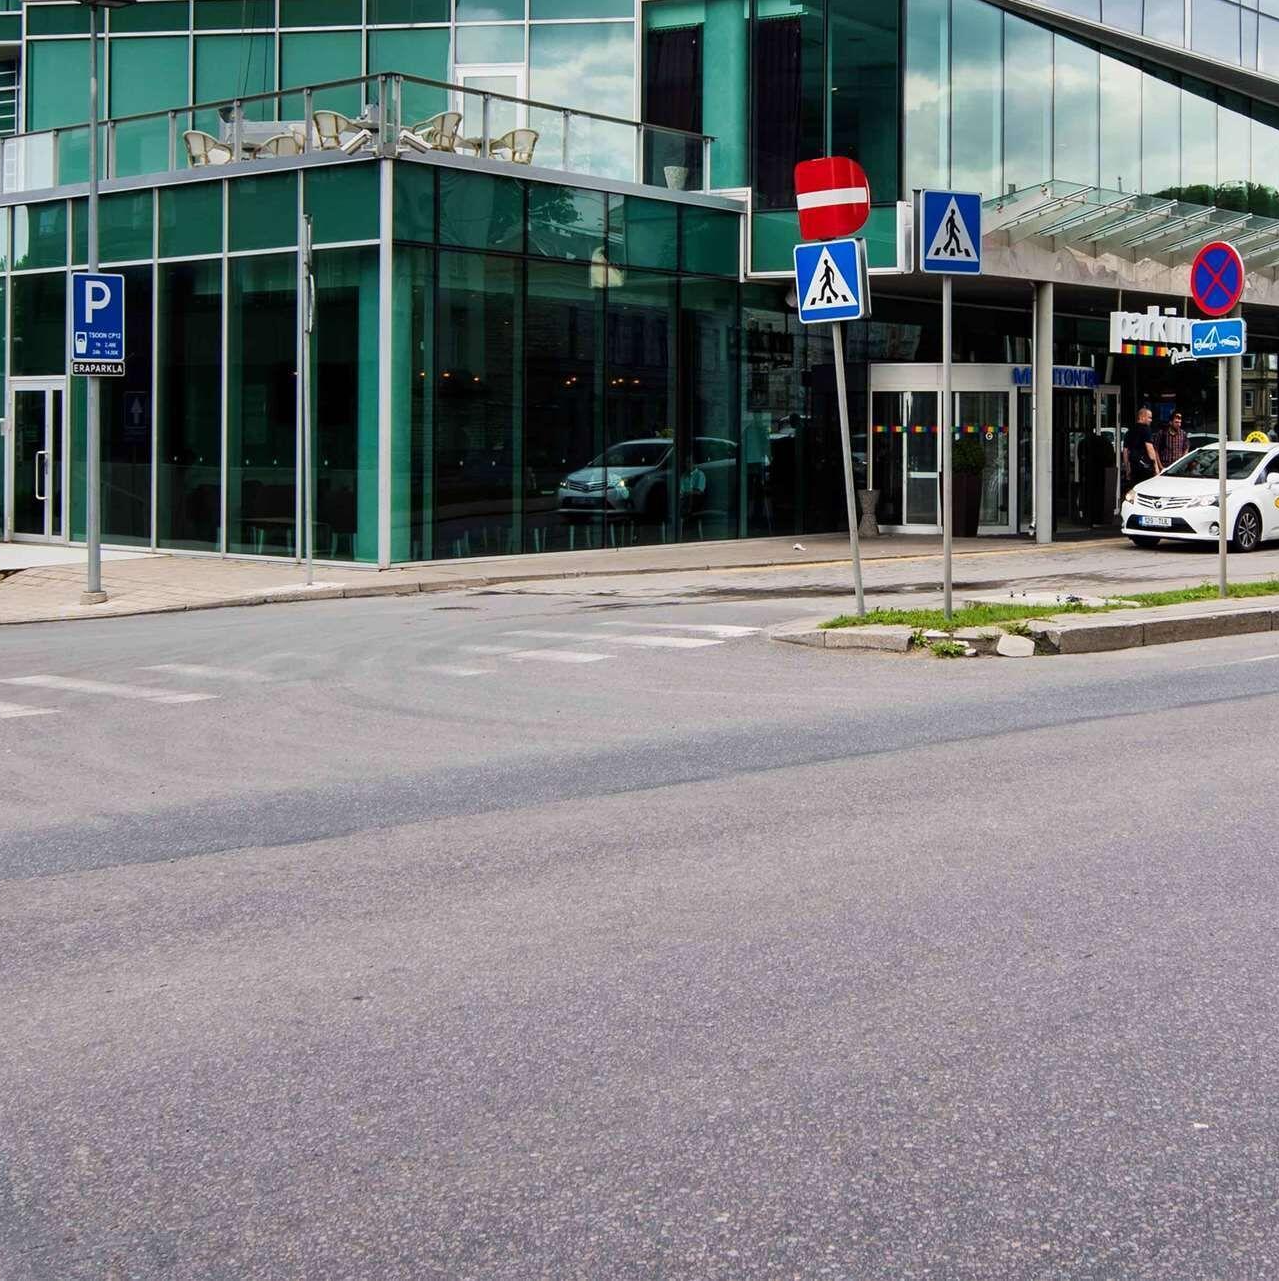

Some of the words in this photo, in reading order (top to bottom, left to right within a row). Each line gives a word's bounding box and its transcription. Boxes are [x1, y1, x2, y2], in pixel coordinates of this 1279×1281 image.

[85, 280, 112, 324] P
[1109, 305, 1168, 354] park
[73, 363, 124, 374] ERAPARKLA
